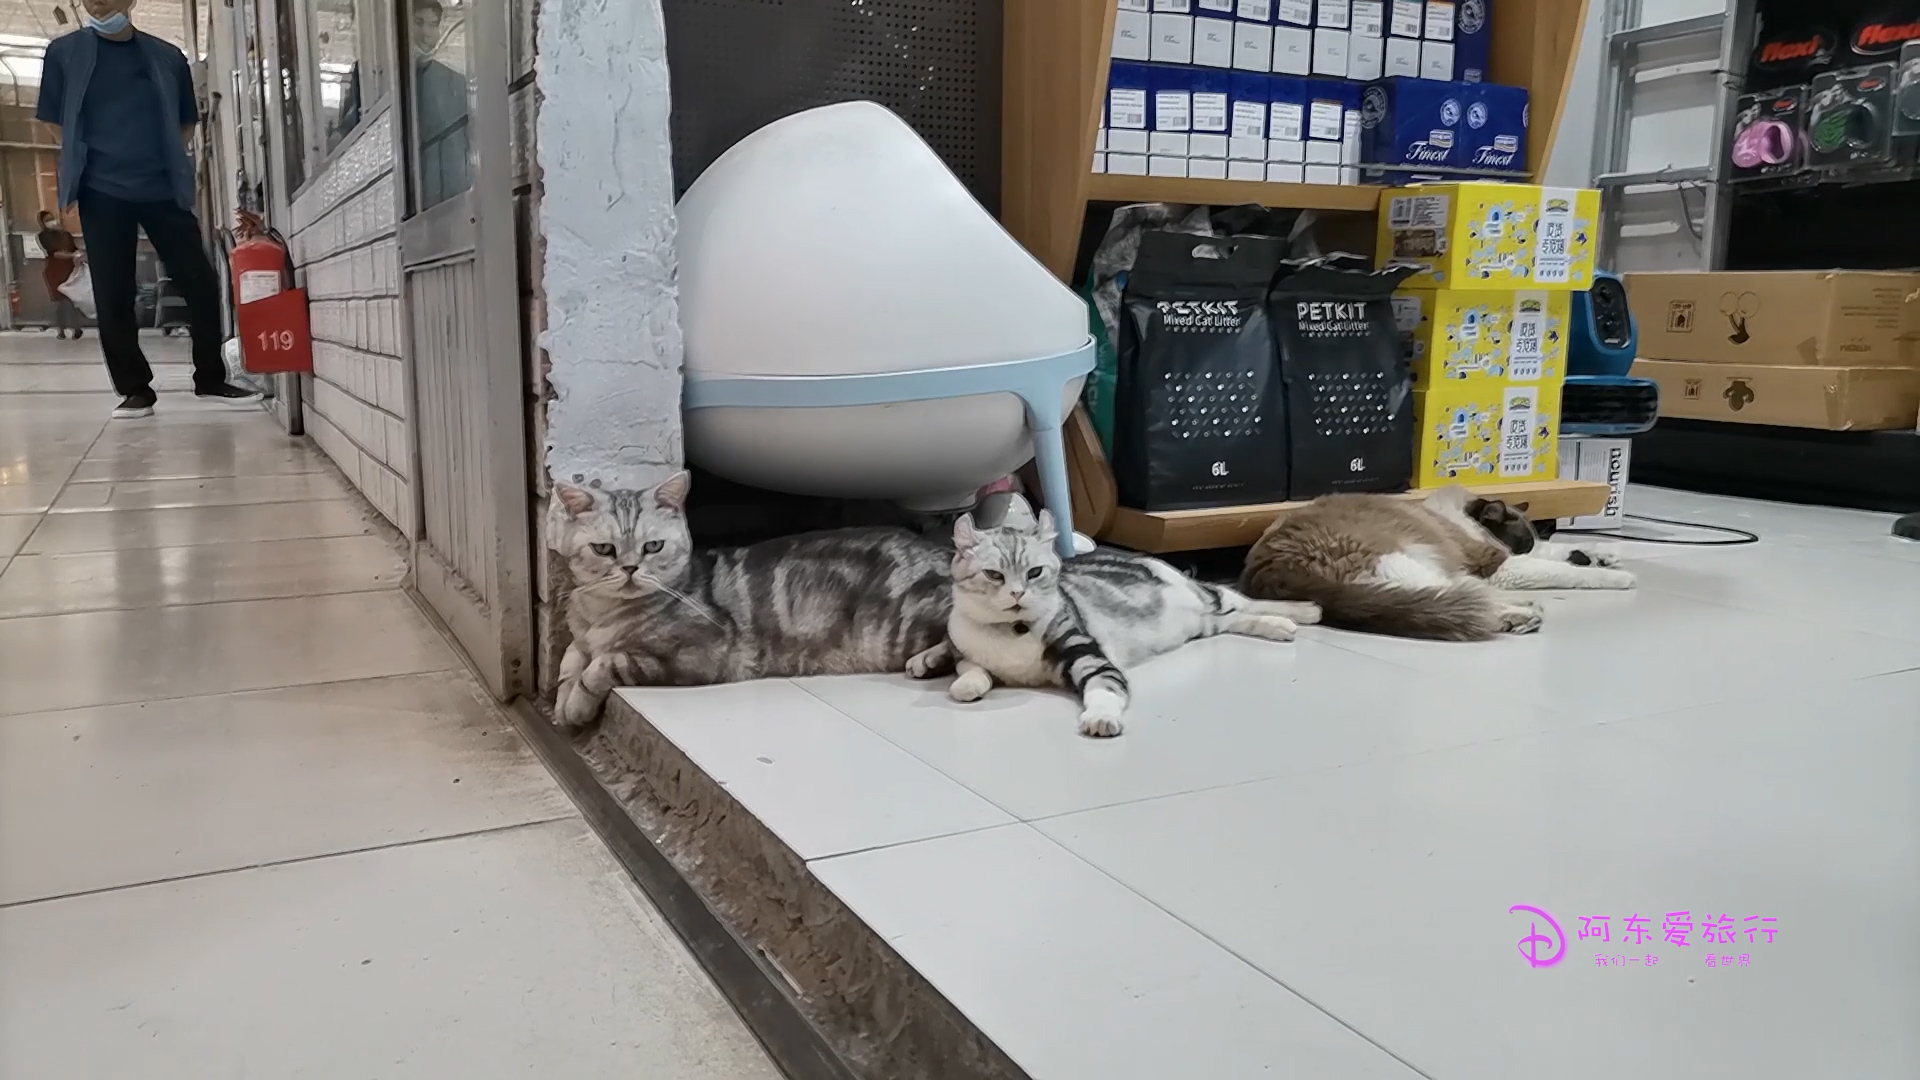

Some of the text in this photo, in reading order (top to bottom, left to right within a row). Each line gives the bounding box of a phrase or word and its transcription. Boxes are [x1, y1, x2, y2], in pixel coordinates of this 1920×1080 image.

[1405, 140, 1451, 162] Finest
[1472, 145, 1515, 166] Finest
[1157, 300, 1239, 315] PETKIT
[1297, 301, 1367, 320] PETKIT
[1163, 314, 1241, 327] Mixed Cat Litter
[1298, 321, 1369, 331] Mixed Cat Litter
[258, 329, 295, 351] 119
[1211, 461, 1230, 476] 6L
[1350, 457, 1366, 472] 6L
[1604, 448, 1622, 517] nourish
